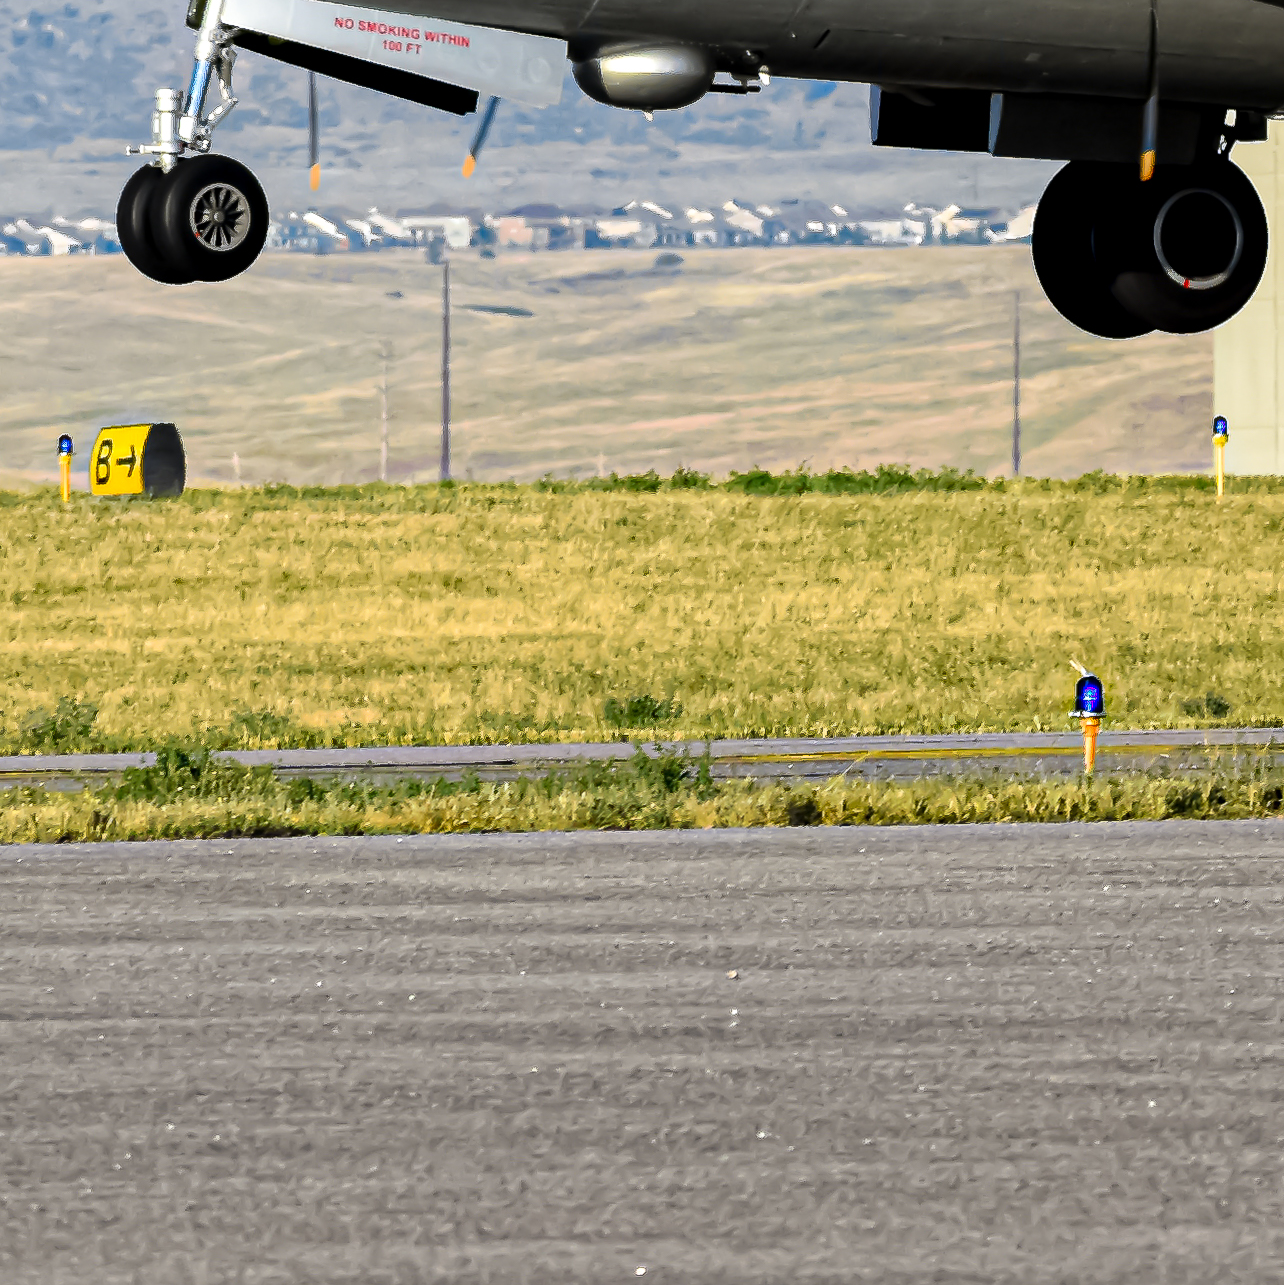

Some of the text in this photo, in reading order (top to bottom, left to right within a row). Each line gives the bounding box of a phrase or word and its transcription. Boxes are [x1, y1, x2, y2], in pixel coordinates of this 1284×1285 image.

[334, 17, 471, 48] NO SMOKING WITHIN
[383, 39, 423, 55] 100 FT
[96, 439, 113, 486] B
